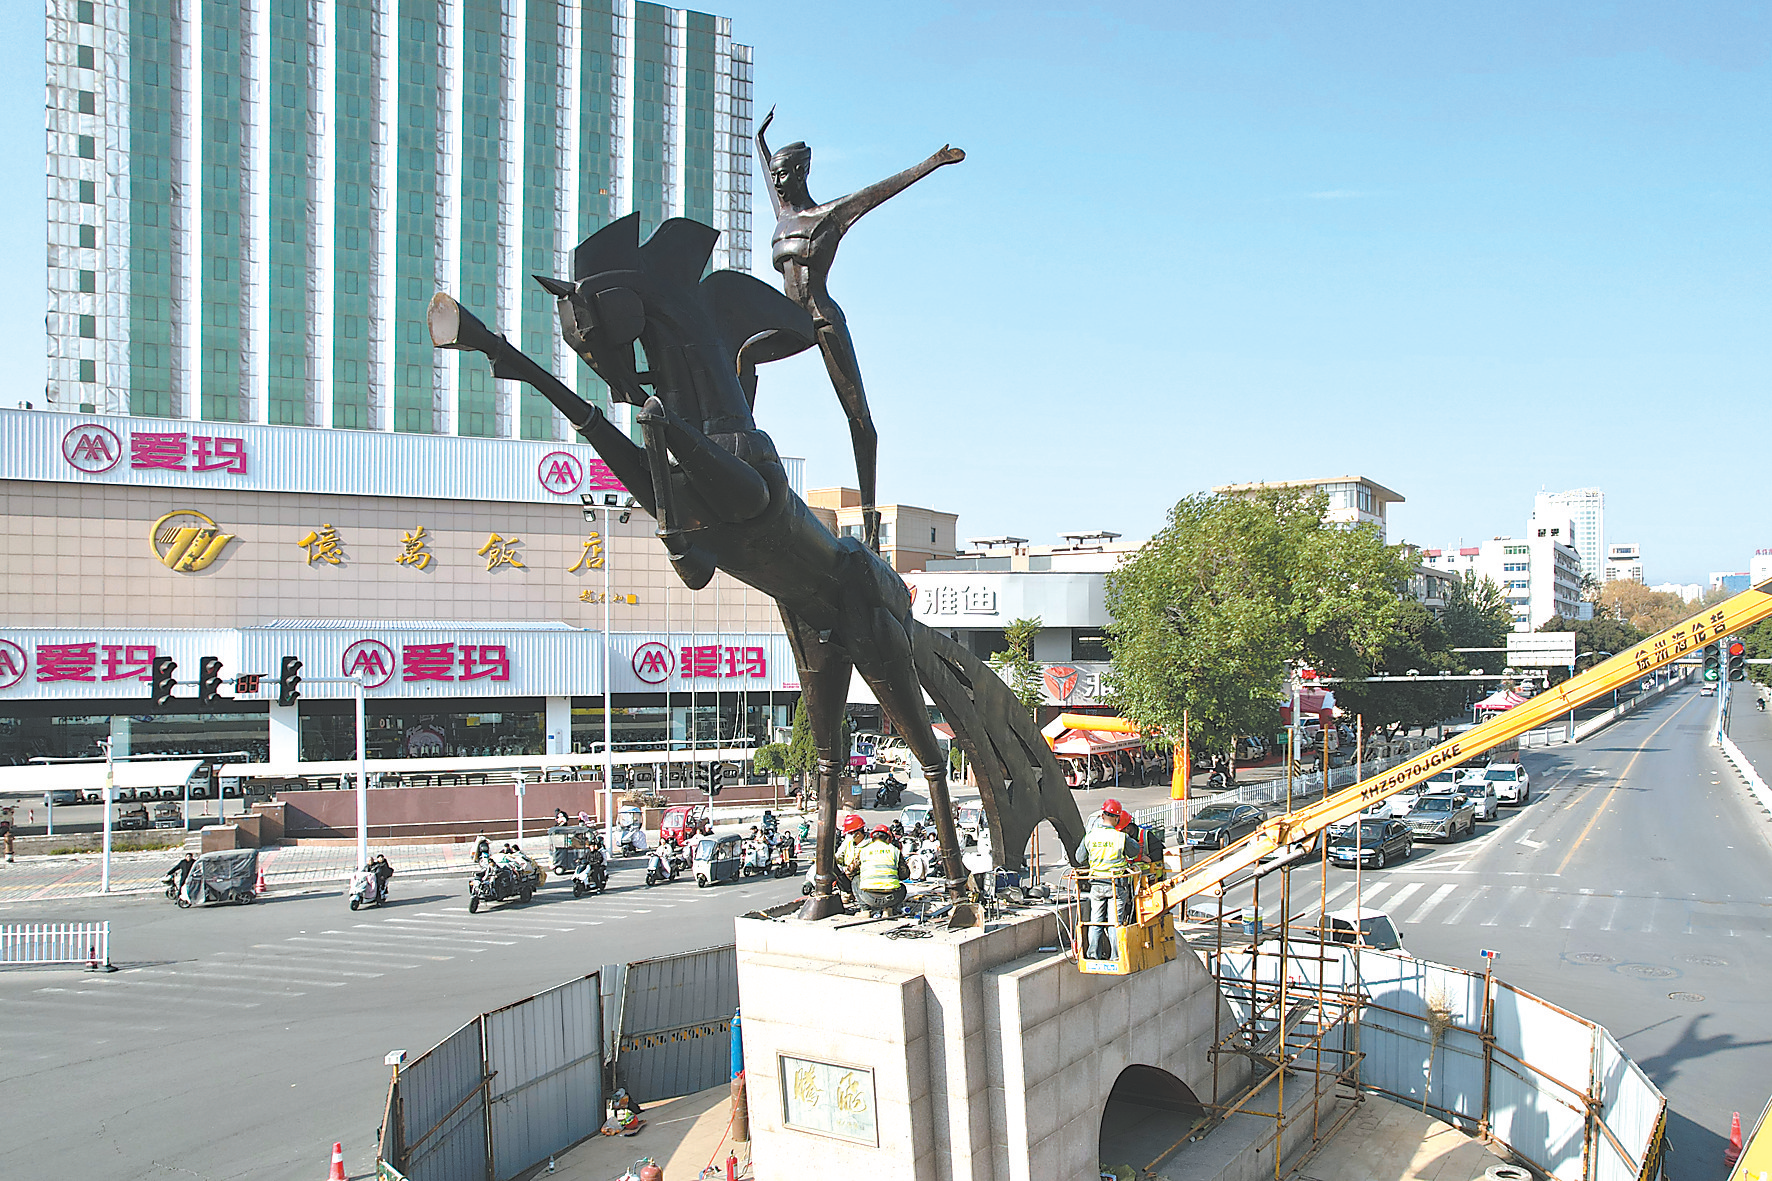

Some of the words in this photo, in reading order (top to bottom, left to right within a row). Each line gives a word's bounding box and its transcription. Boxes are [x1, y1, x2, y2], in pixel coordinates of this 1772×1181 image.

[131, 432, 247, 474] 爱玛
[922, 586, 999, 617] 雅迪
[36, 642, 157, 683] 爱玛
[402, 642, 510, 682] 爱玛
[681, 644, 767, 679] 爱玛
[1360, 743, 1462, 802] XHZ5070JGKE
